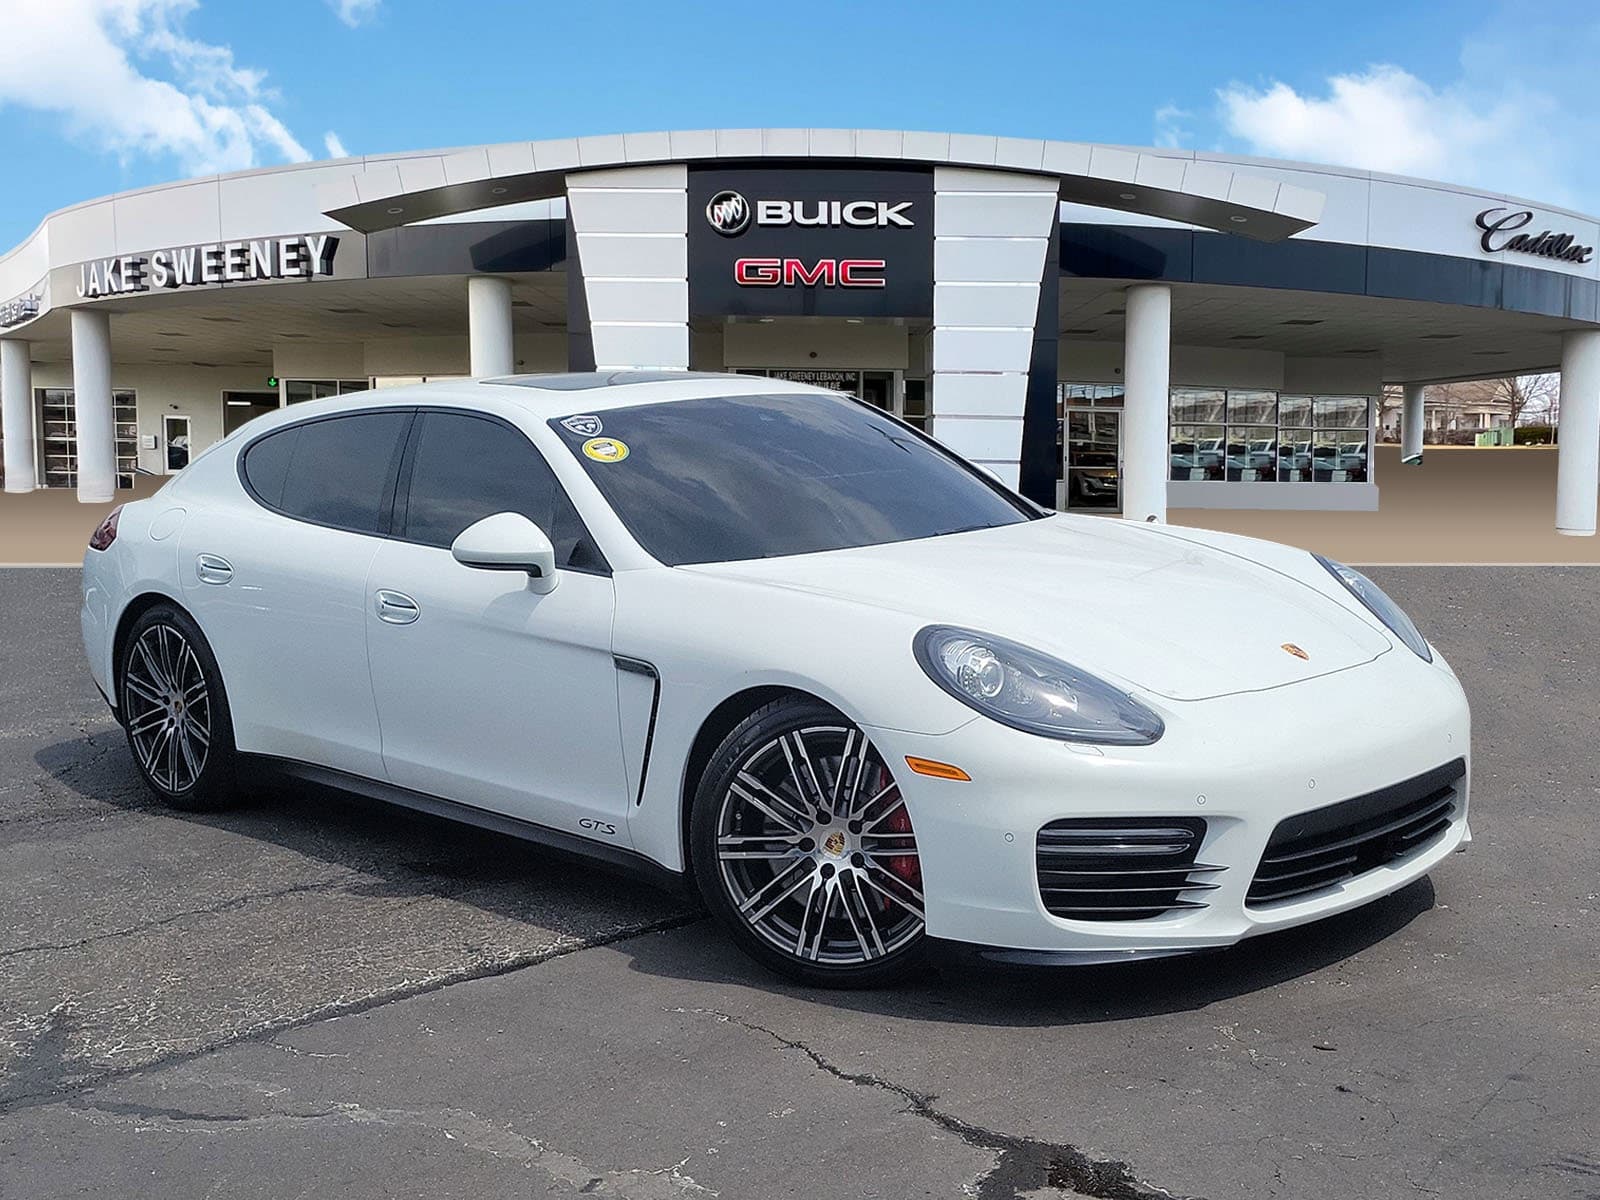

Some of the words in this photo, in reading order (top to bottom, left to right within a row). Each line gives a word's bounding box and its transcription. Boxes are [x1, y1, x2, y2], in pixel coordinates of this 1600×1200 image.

[757, 201, 915, 227] BUICK
[1475, 207, 1593, 263] Cadillac
[76, 256, 142, 298] JAKE
[151, 234, 333, 288] SWEENEY
[735, 258, 886, 286] GMC
[788, 371, 815, 381] SWEENEY
[579, 818, 616, 835] GTS
